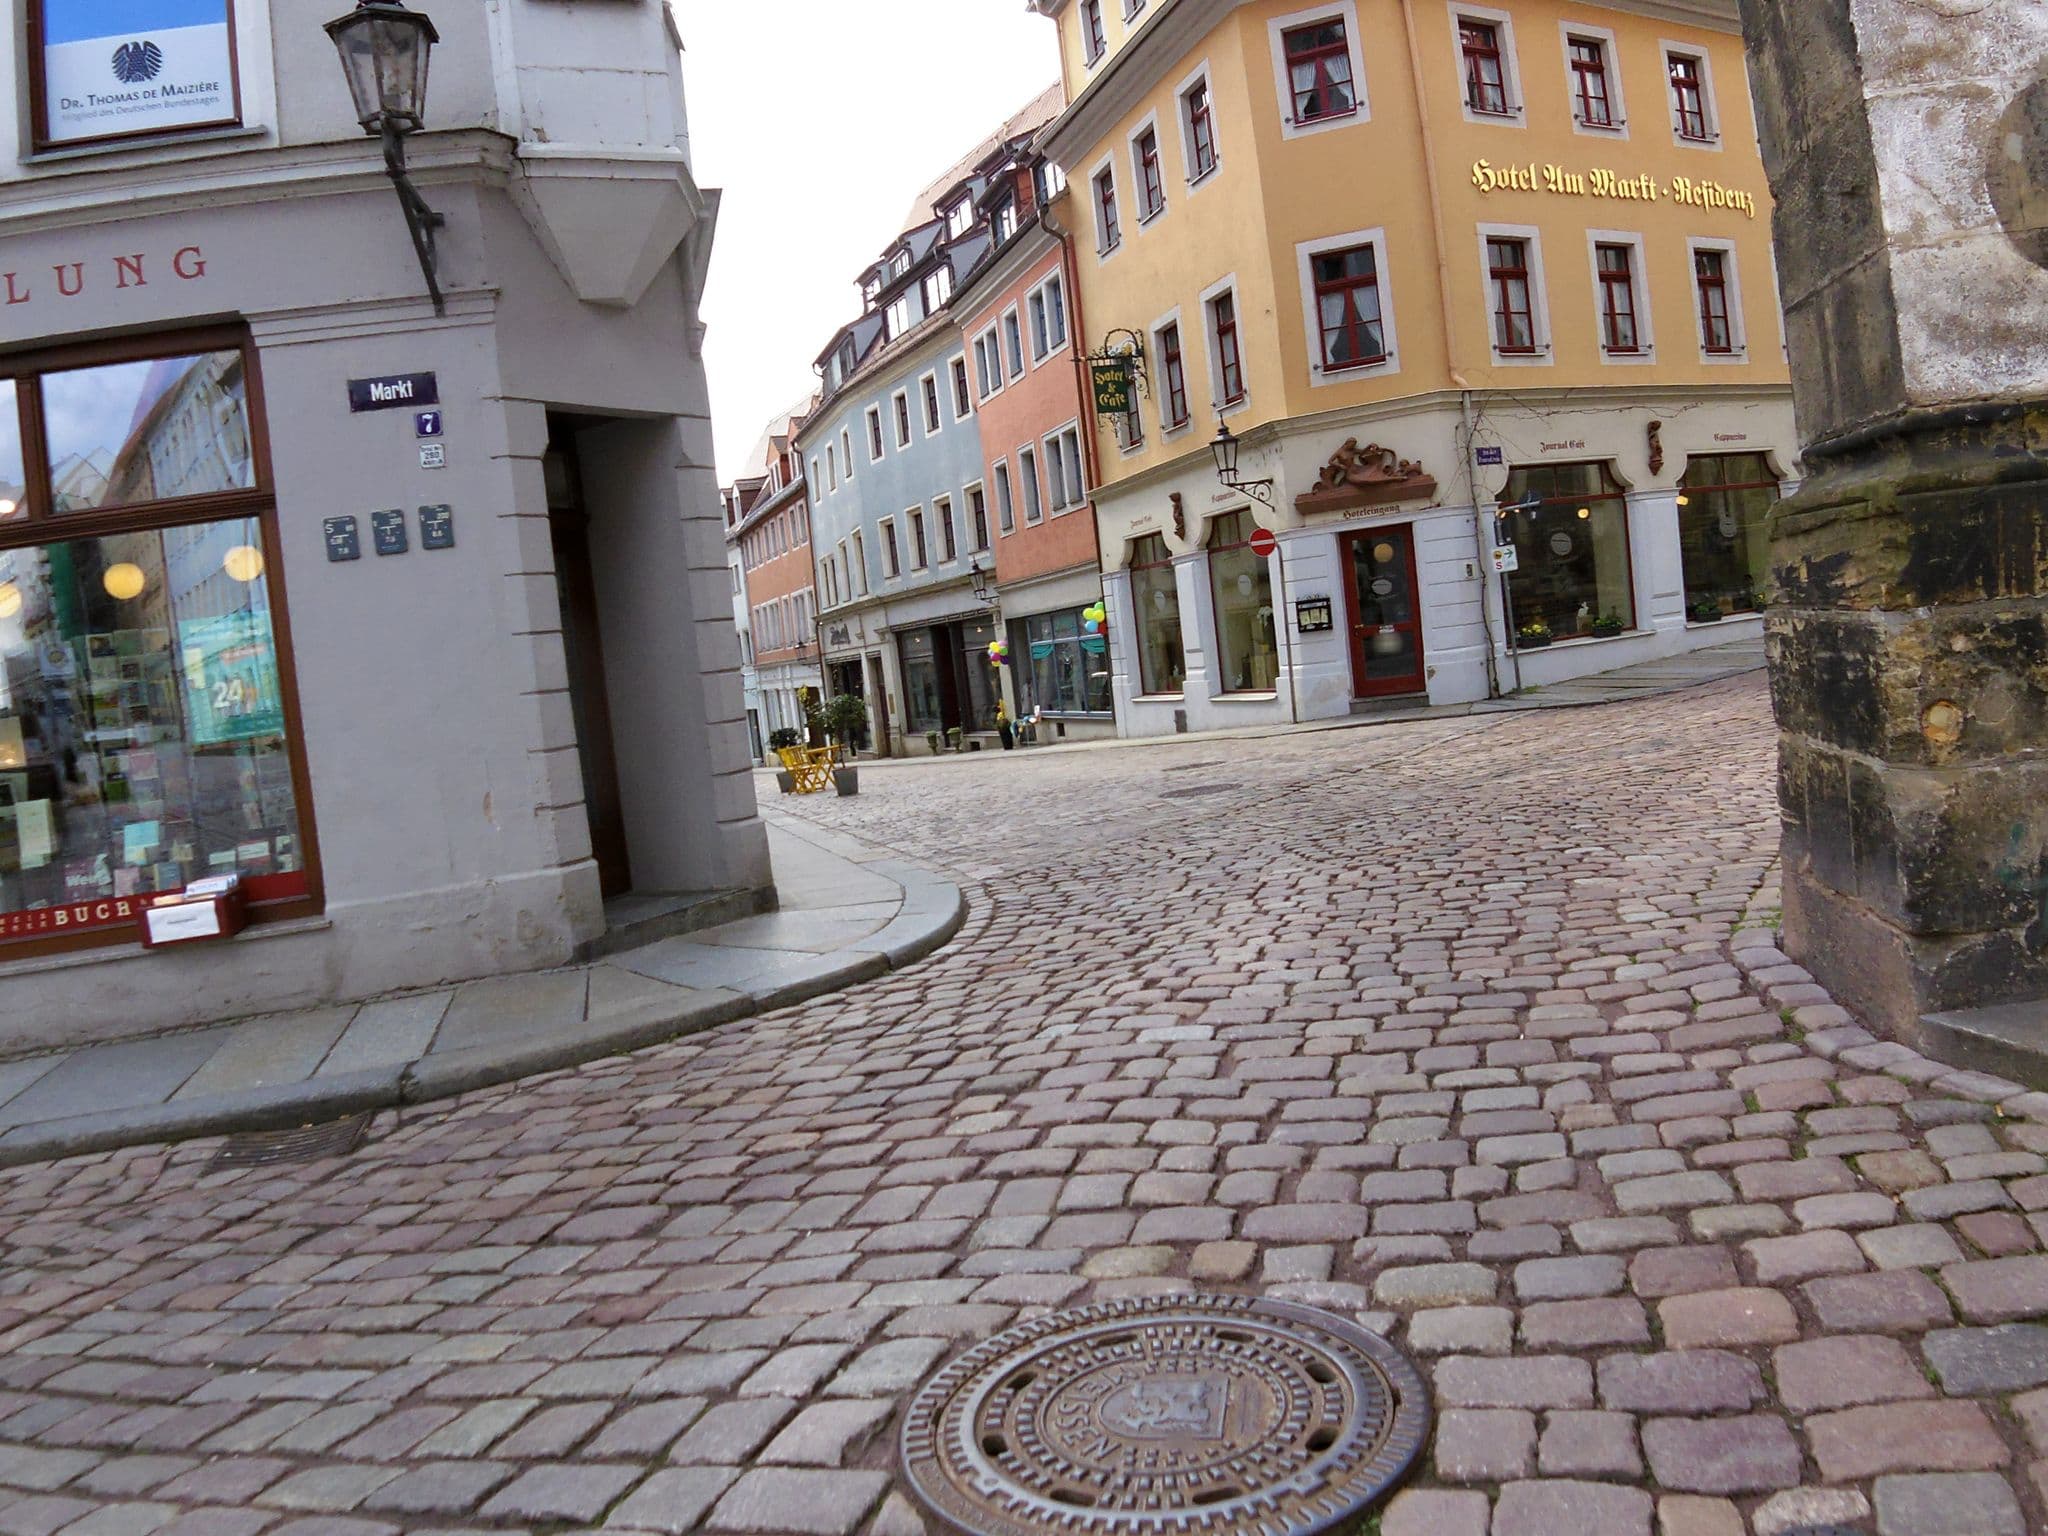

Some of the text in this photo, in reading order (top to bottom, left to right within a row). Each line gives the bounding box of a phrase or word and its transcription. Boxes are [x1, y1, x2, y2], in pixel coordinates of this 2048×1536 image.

[1472, 158, 1539, 193] Hotel
[1542, 163, 1585, 195] Am
[1588, 168, 1657, 201] Markt
[1095, 370, 1124, 385] Hotel
[370, 380, 413, 401] Markt
[422, 413, 433, 433] 7
